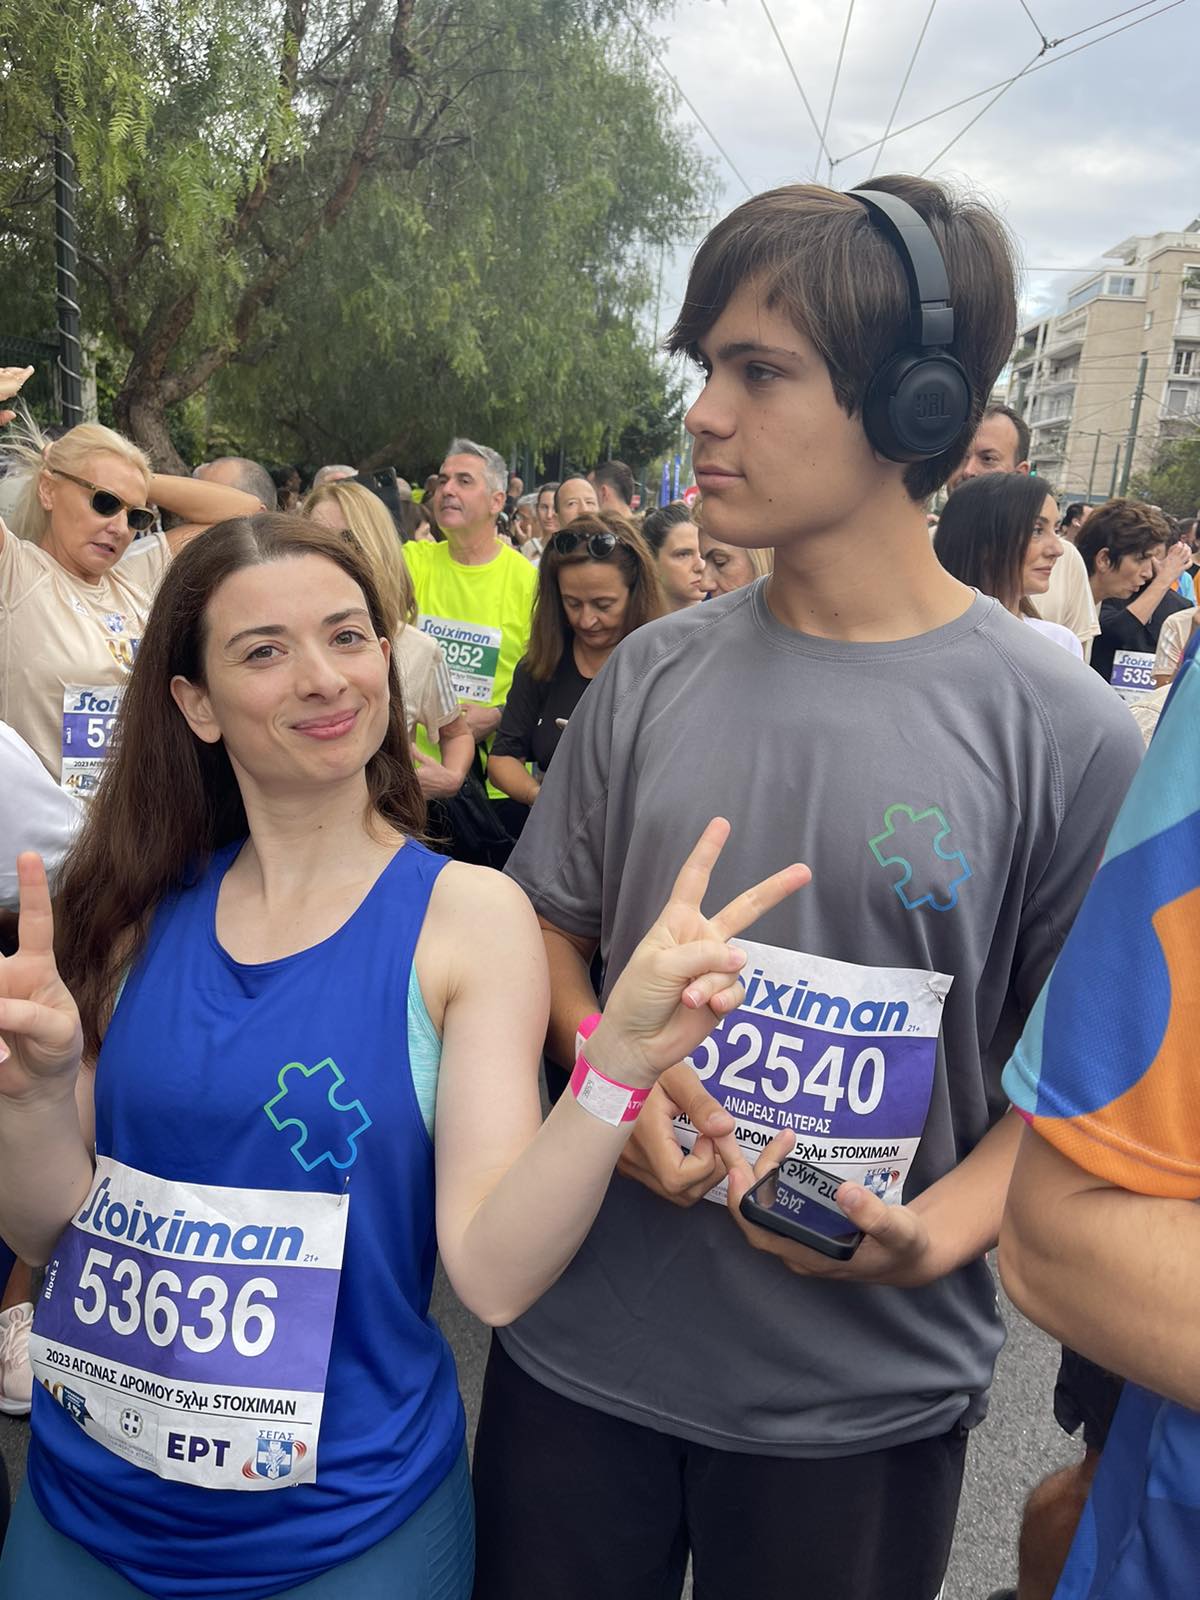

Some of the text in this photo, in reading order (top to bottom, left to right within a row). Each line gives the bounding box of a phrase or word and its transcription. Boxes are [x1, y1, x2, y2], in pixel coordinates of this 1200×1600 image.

[913, 393, 952, 419] JBL
[420, 619, 491, 645] Stoiximan
[433, 637, 484, 668] 6952
[1119, 655, 1154, 667] Stoixi
[73, 692, 119, 712] Stoi
[906, 1024, 921, 1033] 21+
[723, 1095, 776, 1125] ΑΝΔΡΕΑΣ
[776, 1110, 832, 1134] ΠΑΤΕΡΑΣ
[735, 1127, 900, 1161] ΔΡΟΜ 5χλμ STOIXIMAN
[78, 1176, 320, 1263] Stoiximan 21+
[44, 1259, 60, 1300] Block 2
[73, 1248, 278, 1358] 53636
[46, 1348, 297, 1416] 2023 ΑΓΩΝΑΣ ΔΡΟΜΟΥ 5χλμ STOIXIMAN
[167, 1431, 231, 1467] ΕΡΤ
[258, 1429, 295, 1441] ΣΕΓΑΣ
